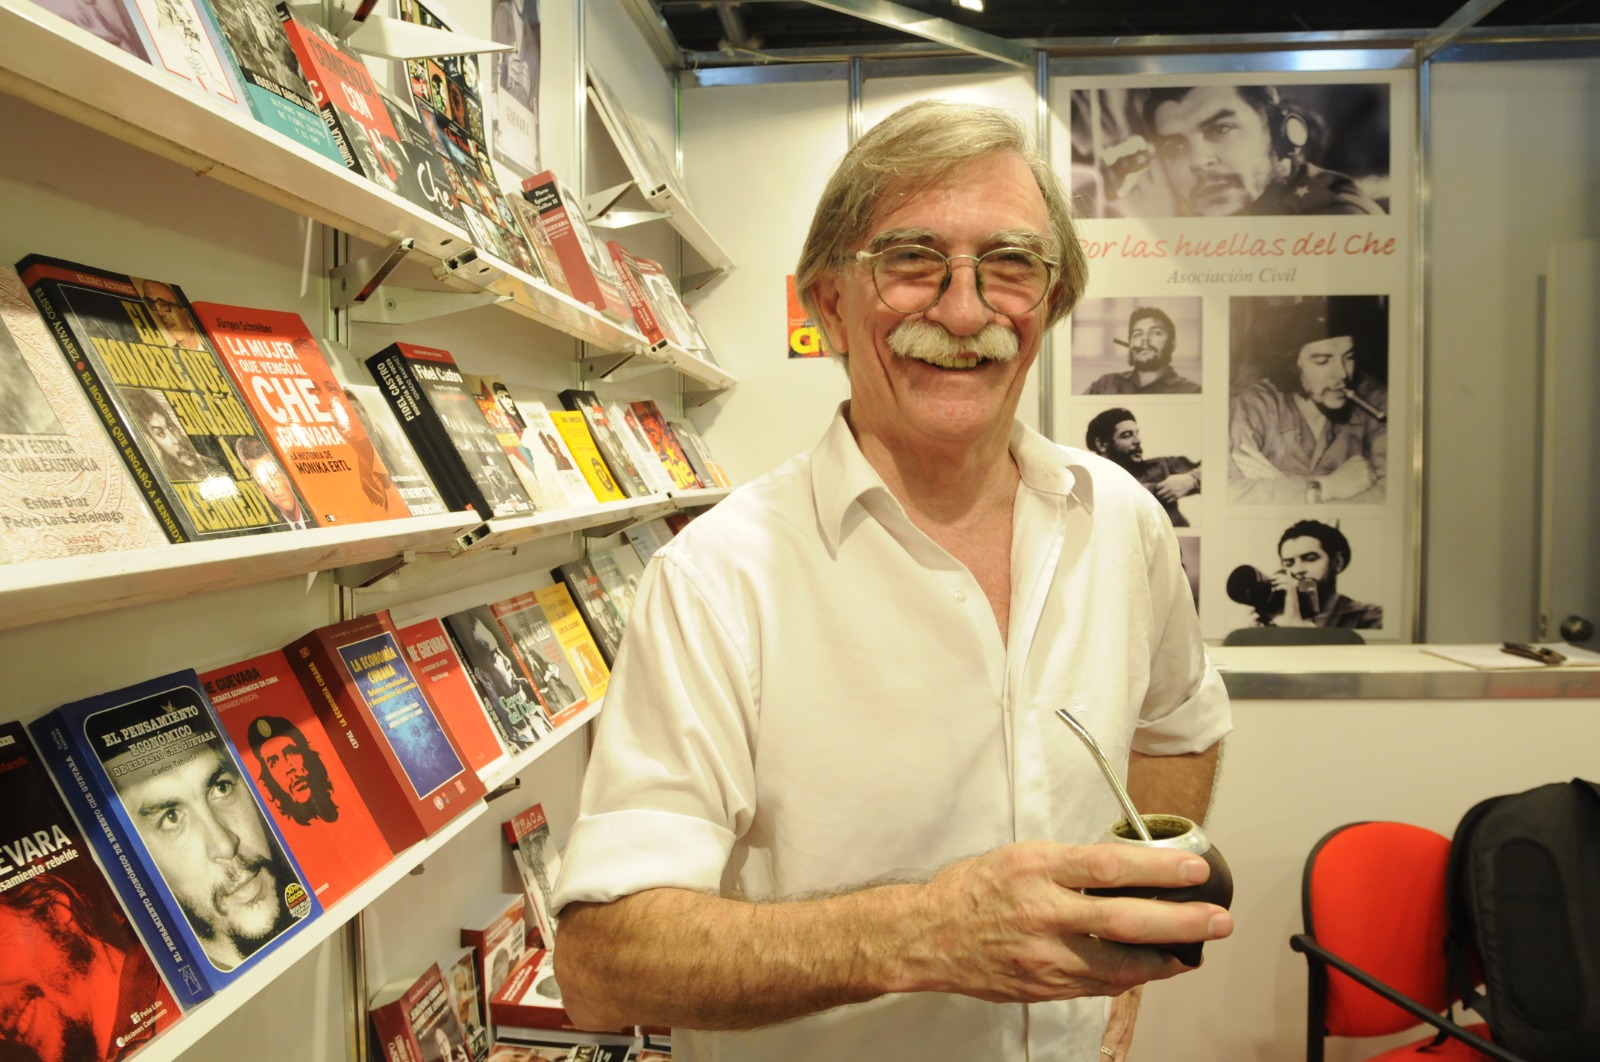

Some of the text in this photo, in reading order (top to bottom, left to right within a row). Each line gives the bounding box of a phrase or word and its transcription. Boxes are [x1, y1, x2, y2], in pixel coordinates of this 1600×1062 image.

[308, 37, 375, 98] COMIENZA
[341, 82, 374, 121] CON
[322, 108, 336, 128] CON
[331, 127, 355, 168] COMIENZA
[417, 160, 454, 211] Che
[1121, 234, 1168, 258] las
[1174, 233, 1286, 258] huellas
[1292, 231, 1338, 256] del
[1344, 230, 1397, 256] Che
[1167, 267, 1297, 284] Asociación Civil
[121, 301, 168, 347] EL
[239, 320, 273, 334] Schreiber
[225, 336, 299, 360] LA MUJER
[90, 337, 233, 395] HOMBRE QUE
[238, 359, 308, 376] QUE VENGÓ AL
[385, 358, 398, 375] VOCES
[413, 364, 464, 384] Fidel Castro
[251, 376, 334, 424] CHE
[377, 362, 415, 422] FIDEL CASTRO
[34, 287, 184, 544] ELISEO ÁLVAREZ EL HOMBRE QUE ENGAÑÓ A KENNEDY
[487, 409, 512, 429] Che
[217, 436, 250, 480] A
[295, 460, 352, 475] MONIKA ERTL
[299, 452, 323, 461] HISTORIA
[323, 451, 333, 459] DE
[173, 480, 280, 531] KENNEDY
[529, 621, 551, 642] CHE
[350, 645, 398, 673] LA ECONOMÍA
[406, 634, 449, 663] HE GUEVARA
[203, 667, 261, 694] HE GUEVARA
[367, 664, 397, 684] CUBANA
[212, 691, 232, 704] DEBATE
[231, 682, 260, 697] ECONÓMICO
[265, 676, 279, 685] CUBA
[483, 696, 493, 711] Che
[308, 661, 360, 750] CEPAL LA ECONOMÍA CUBANA
[102, 705, 199, 747] EL PENSAMIENTO
[128, 724, 193, 757] ECONÓMICO
[112, 731, 216, 777] DE ERNESTO CHE GUEVARA
[152, 754, 197, 776] Carlos Tablada
[0, 825, 72, 877] EVARA
[65, 755, 182, 964] EL PENSAMIENTO ECONÓMICO DE ERNESTO CHE GUEVARA
[0, 848, 79, 893] samiento rebelde
